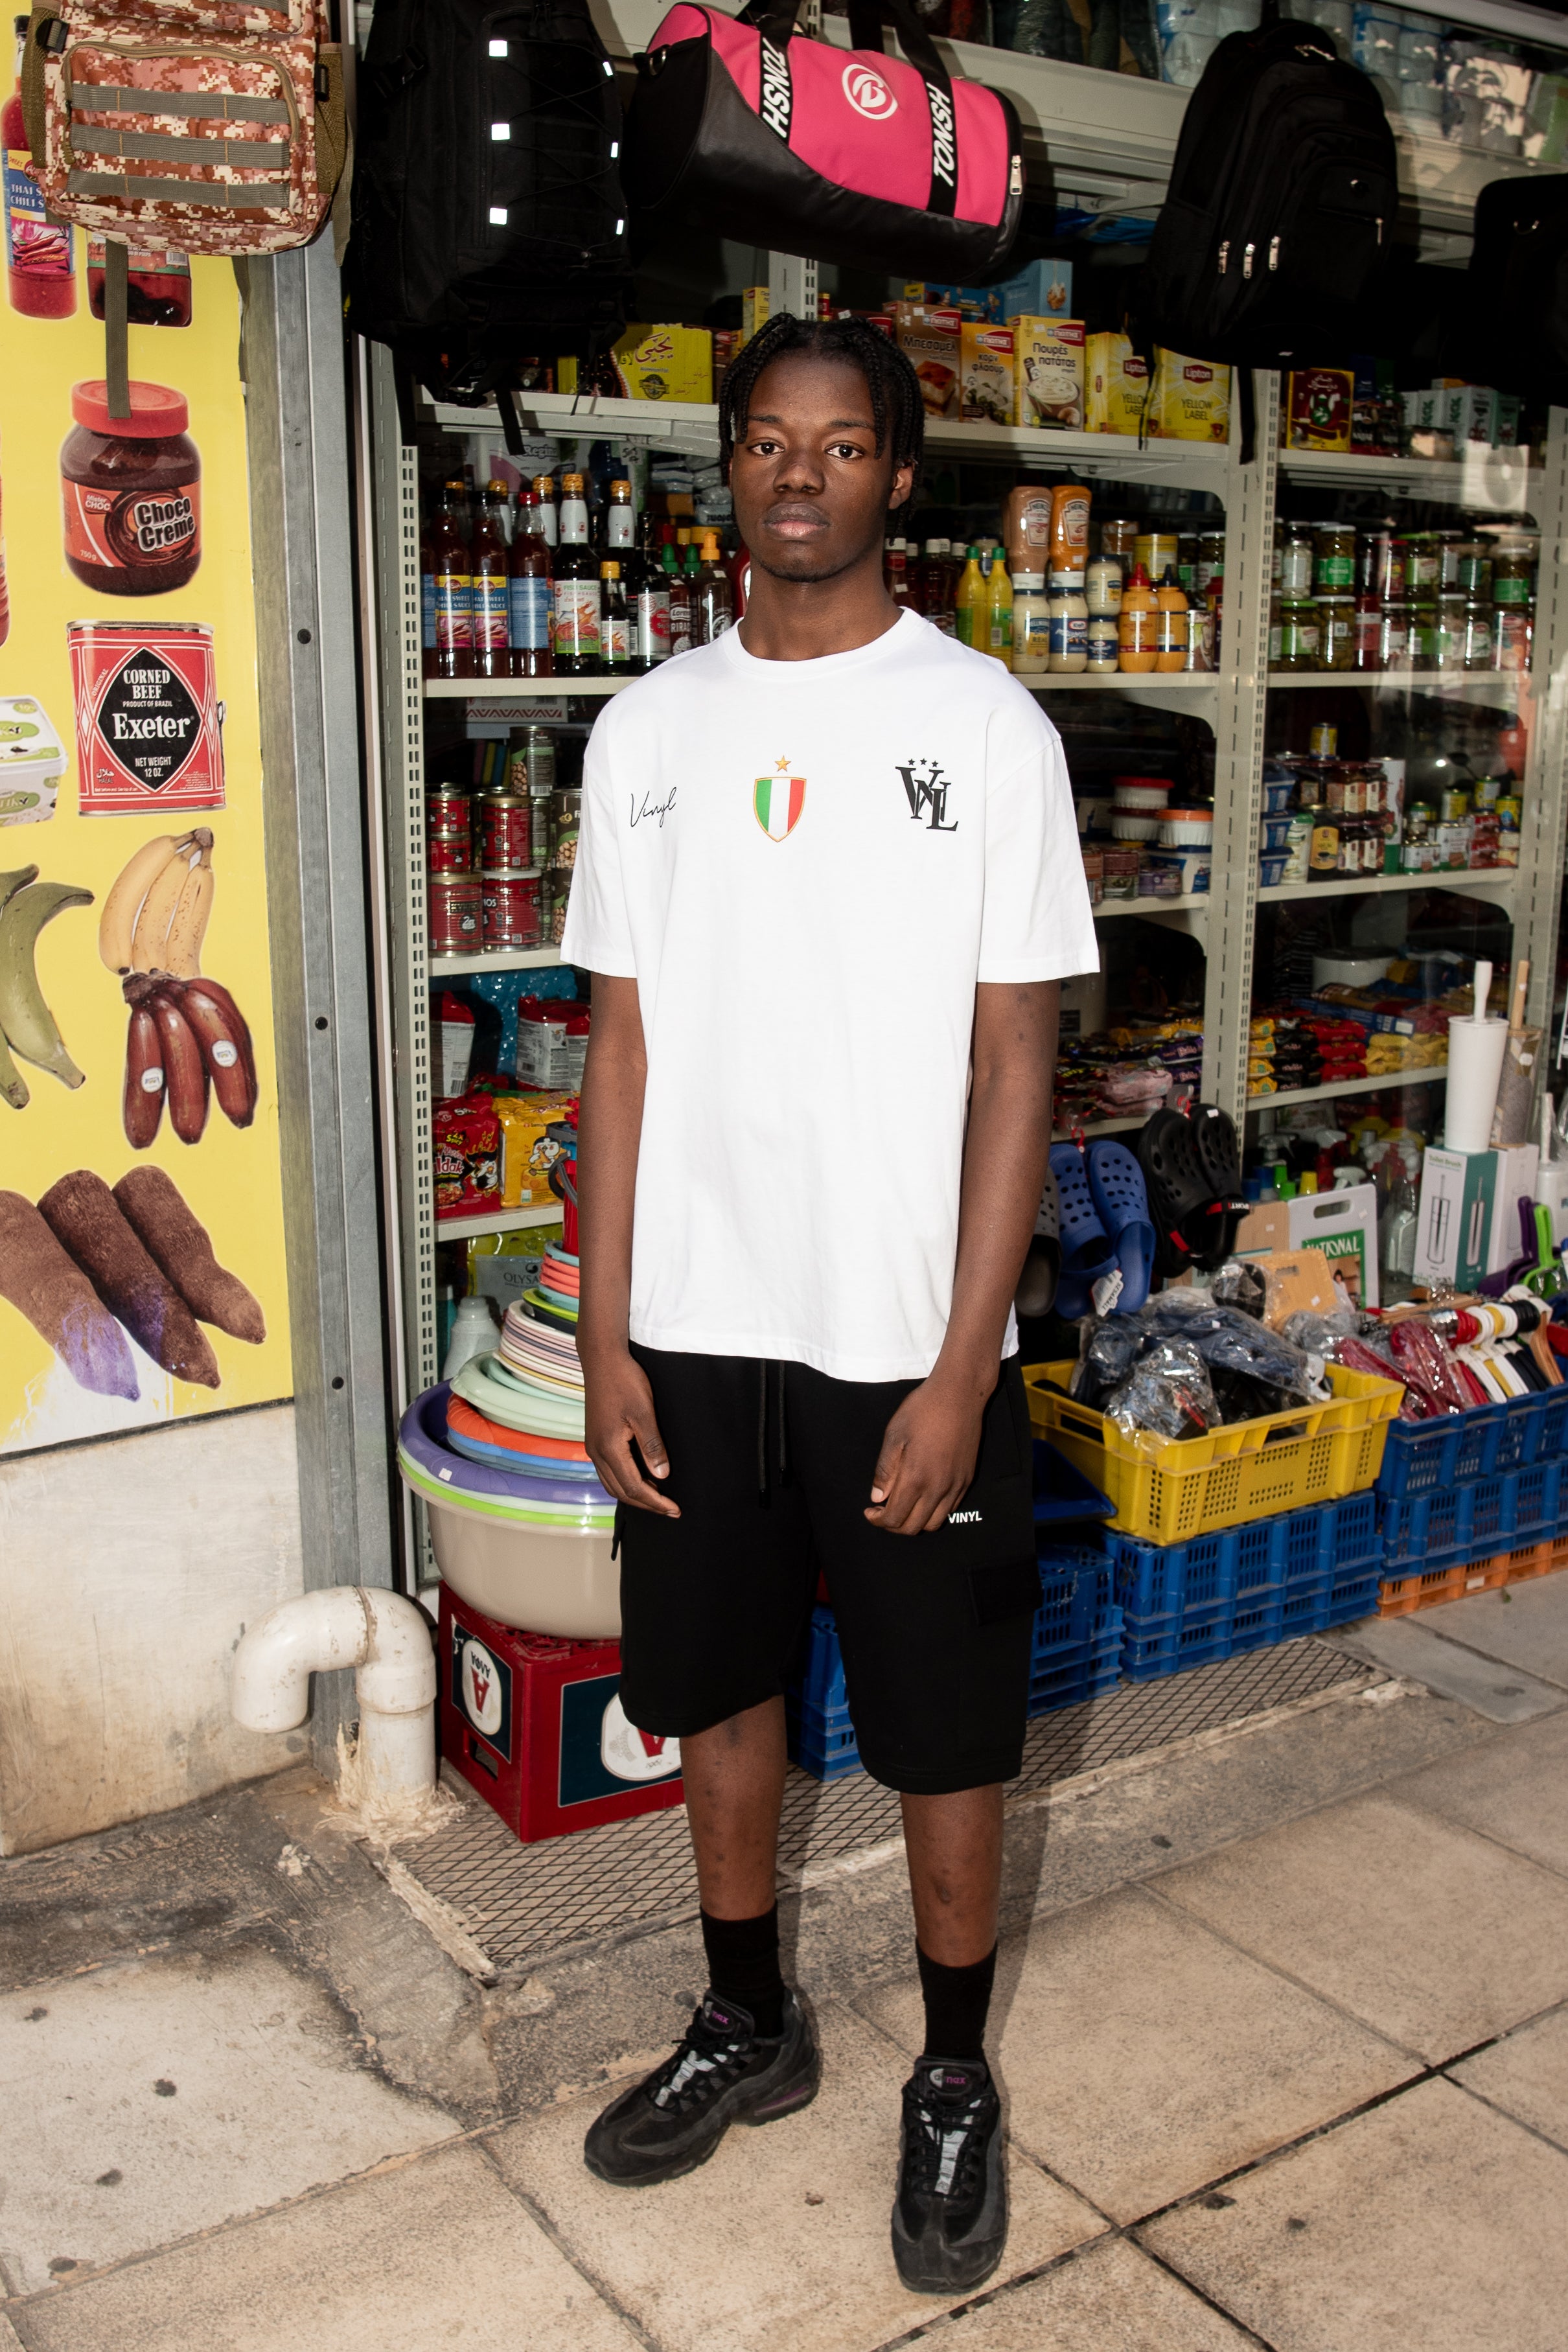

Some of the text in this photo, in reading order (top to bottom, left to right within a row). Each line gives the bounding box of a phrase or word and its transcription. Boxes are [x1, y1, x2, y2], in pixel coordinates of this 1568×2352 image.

[762, 38, 792, 138] TONSH
[927, 82, 956, 187] TONSH
[11, 184, 33, 195] THAI
[10, 196, 35, 207] CHILI
[1033, 342, 1068, 356] Πουρές
[1186, 368, 1212, 380] Lipton
[1122, 393, 1144, 404] YELLO
[1182, 398, 1213, 411] YELLOW
[1184, 409, 1209, 421] LABEL
[85, 501, 111, 511] CHOC
[135, 497, 191, 526] Choco
[139, 516, 195, 549] Creme
[123, 669, 170, 684] CORNED
[133, 685, 163, 699] BEEF
[112, 713, 190, 739] Exeter
[135, 756, 172, 767] NET WEIGHT
[144, 769, 152, 778] 12
[630, 787, 677, 828] Vinyl
[1306, 1236, 1361, 1258] TIONAL
[948, 1511, 983, 1524] VINYL
